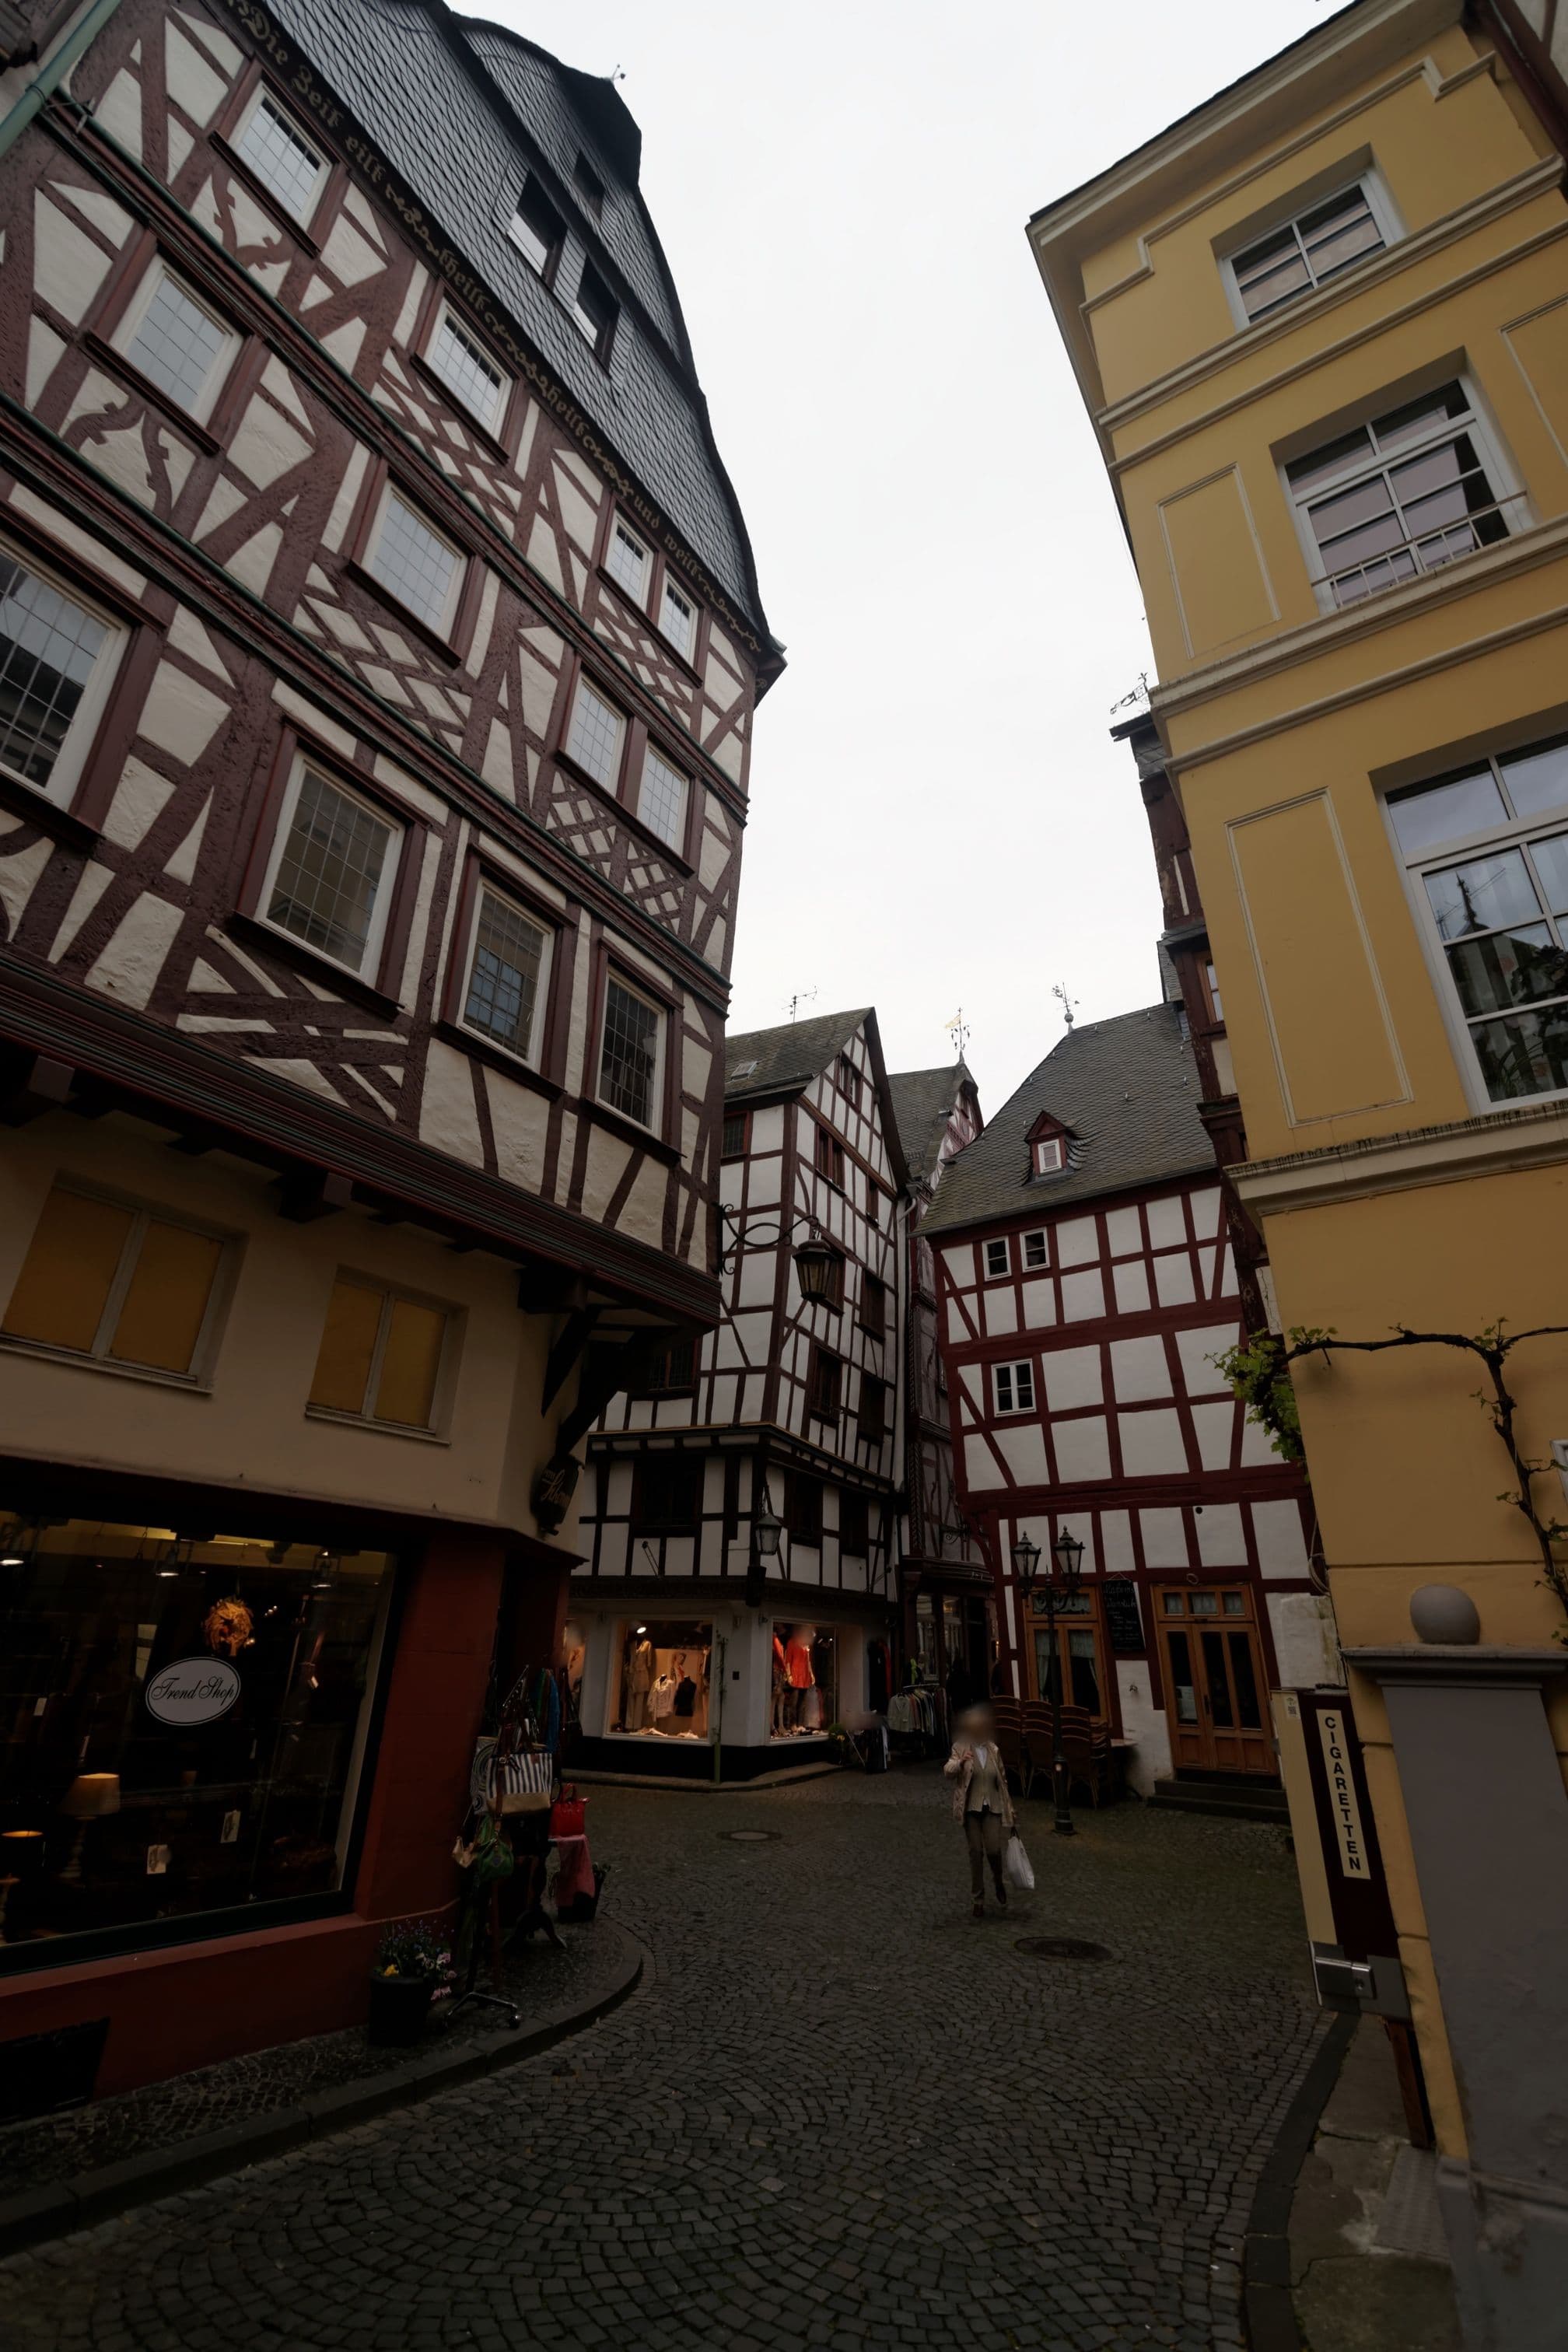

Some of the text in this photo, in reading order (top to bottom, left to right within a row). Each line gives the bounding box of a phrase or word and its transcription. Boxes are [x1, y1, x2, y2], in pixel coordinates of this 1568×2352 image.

[241, 5, 289, 65] Die
[291, 65, 345, 128] Zeit
[345, 135, 387, 183] eilt
[634, 495, 660, 529] und
[151, 1675, 235, 1706] Trend Shop
[1325, 1717, 1362, 1871] CIGARETTEN
